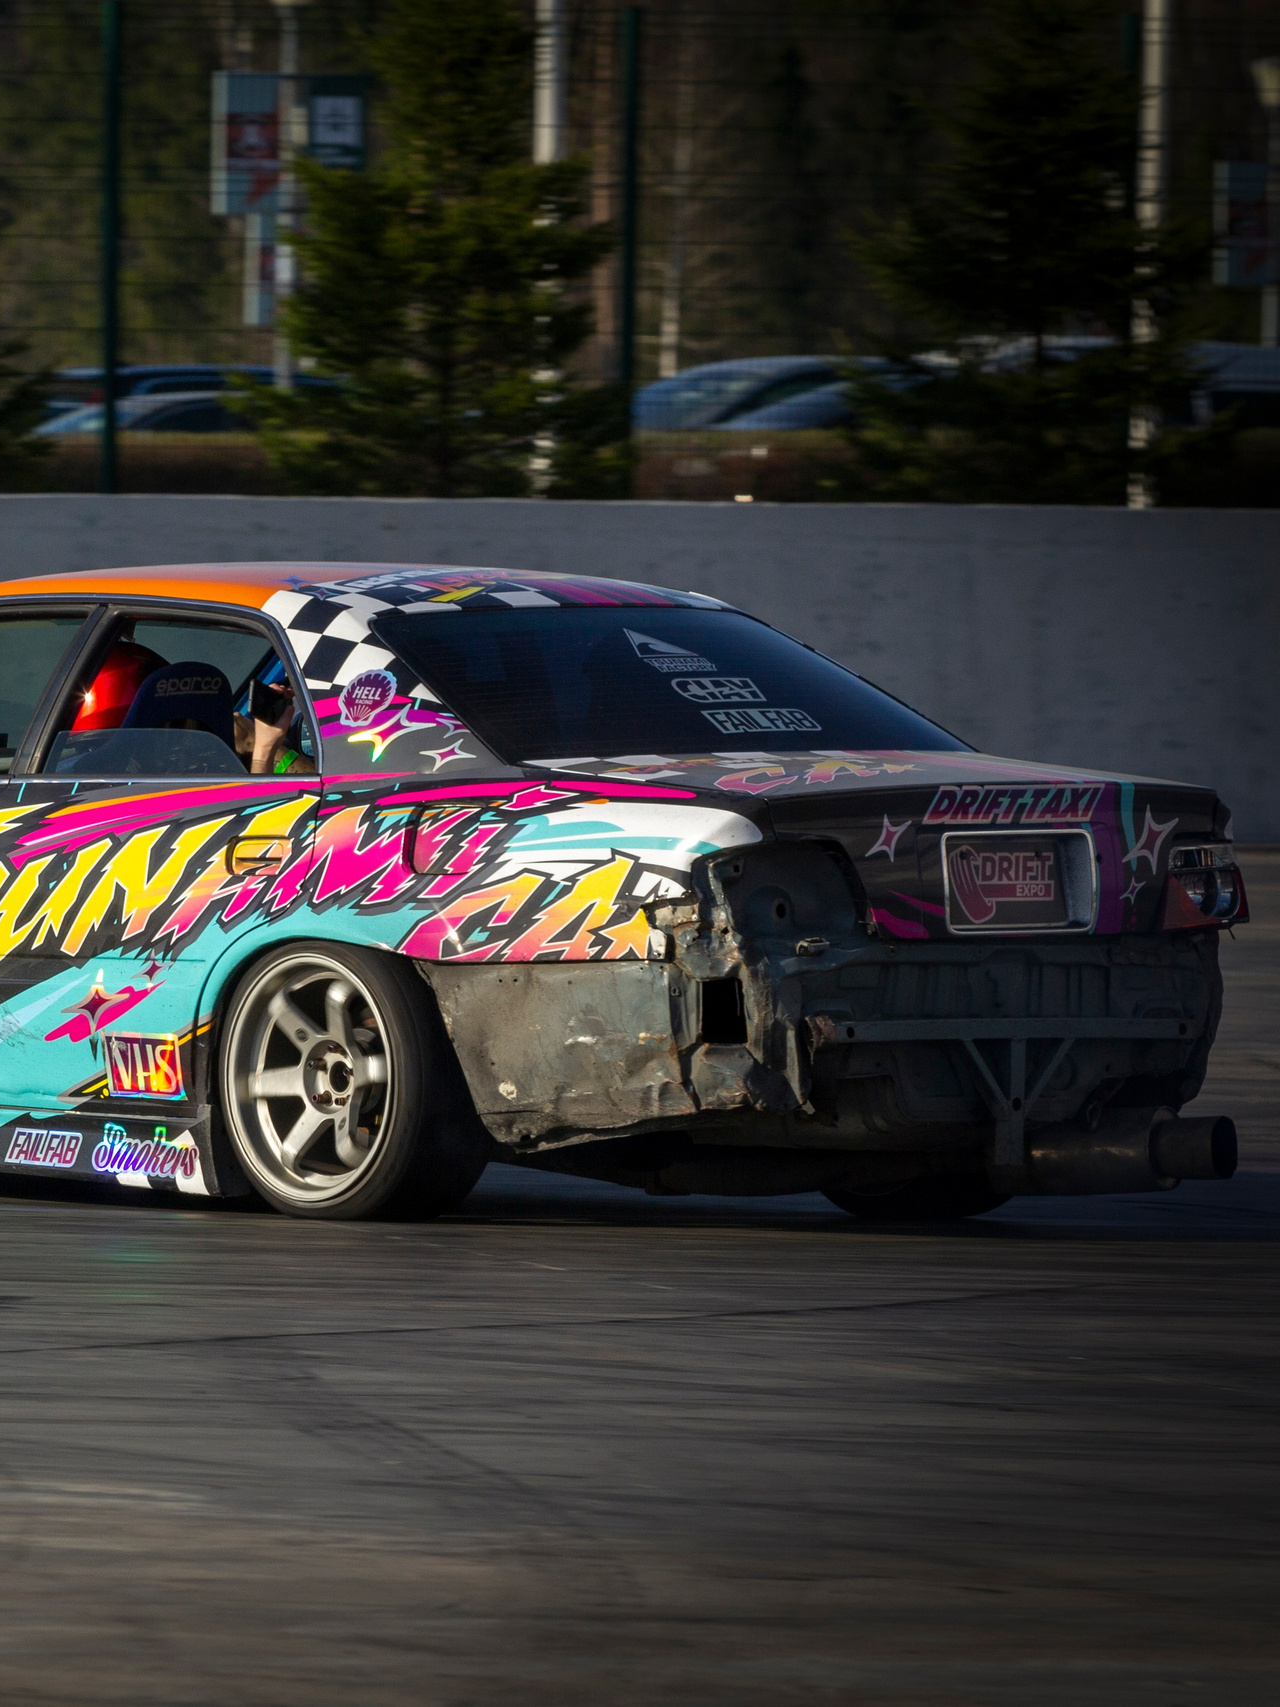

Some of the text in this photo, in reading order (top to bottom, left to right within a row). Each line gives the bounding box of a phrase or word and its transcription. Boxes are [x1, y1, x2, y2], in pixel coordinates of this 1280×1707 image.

[154, 676, 222, 697] sparco
[352, 686, 382, 700] HELL
[980, 854, 1052, 882] DRIFT
[1016, 884, 1045, 896] EXPO
[95, 1125, 198, 1177] Smokers
